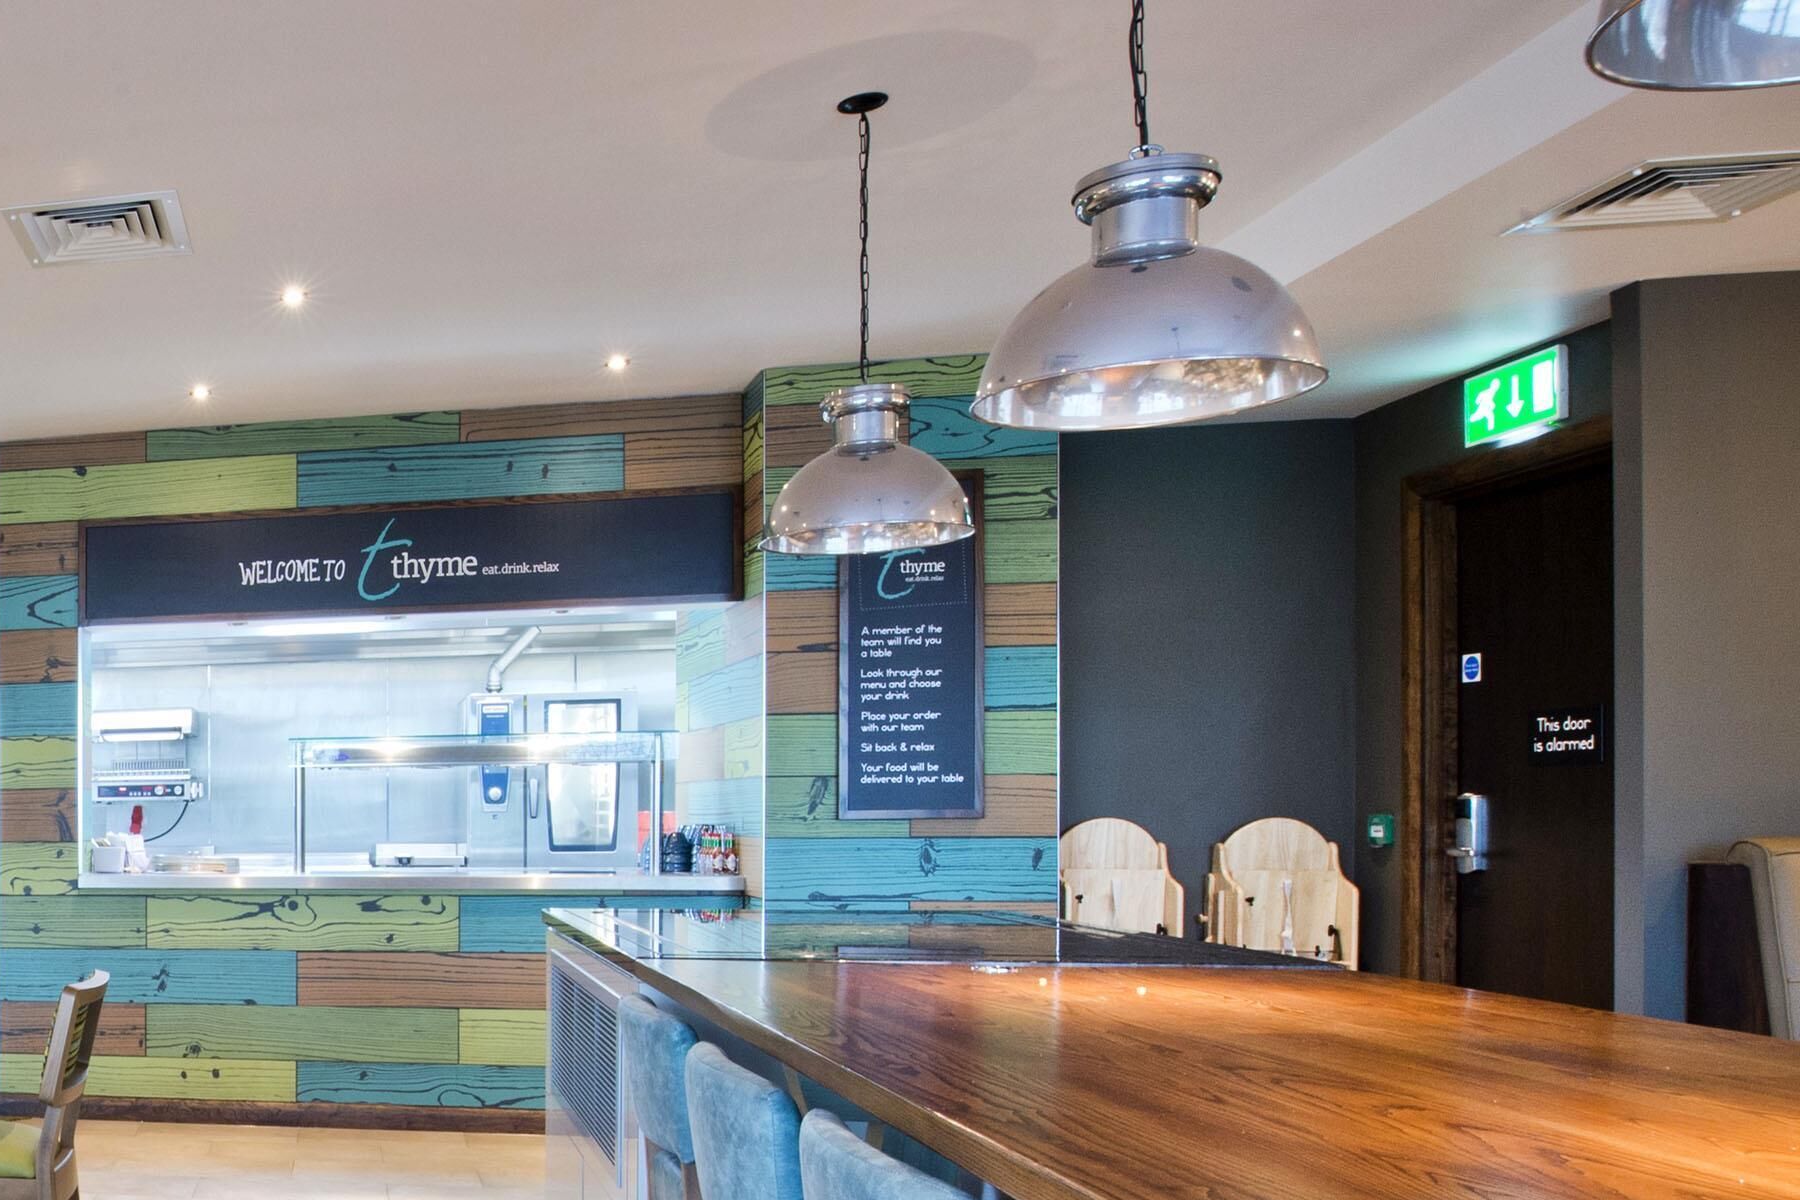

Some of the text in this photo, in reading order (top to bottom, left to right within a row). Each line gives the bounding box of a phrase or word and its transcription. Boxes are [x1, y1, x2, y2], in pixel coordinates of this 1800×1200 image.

[238, 558, 346, 586] WELCOME TO
[390, 552, 560, 584] thyme eat.drink.relax
[899, 559, 946, 576] thyme
[861, 624, 943, 636] A member of the
[861, 635, 942, 647] team will find you
[870, 648, 893, 658] table
[860, 667, 943, 680] Look through our
[860, 679, 942, 689] menu and choose
[860, 690, 910, 703] your drink
[861, 710, 942, 722] Place your order
[860, 723, 925, 732] with our team
[1536, 715, 1592, 733] This door
[861, 742, 935, 752] Sit back & relax
[1533, 734, 1595, 753] is alarmed
[860, 762, 940, 773] Your food will be
[860, 772, 964, 786] delivered to your table
